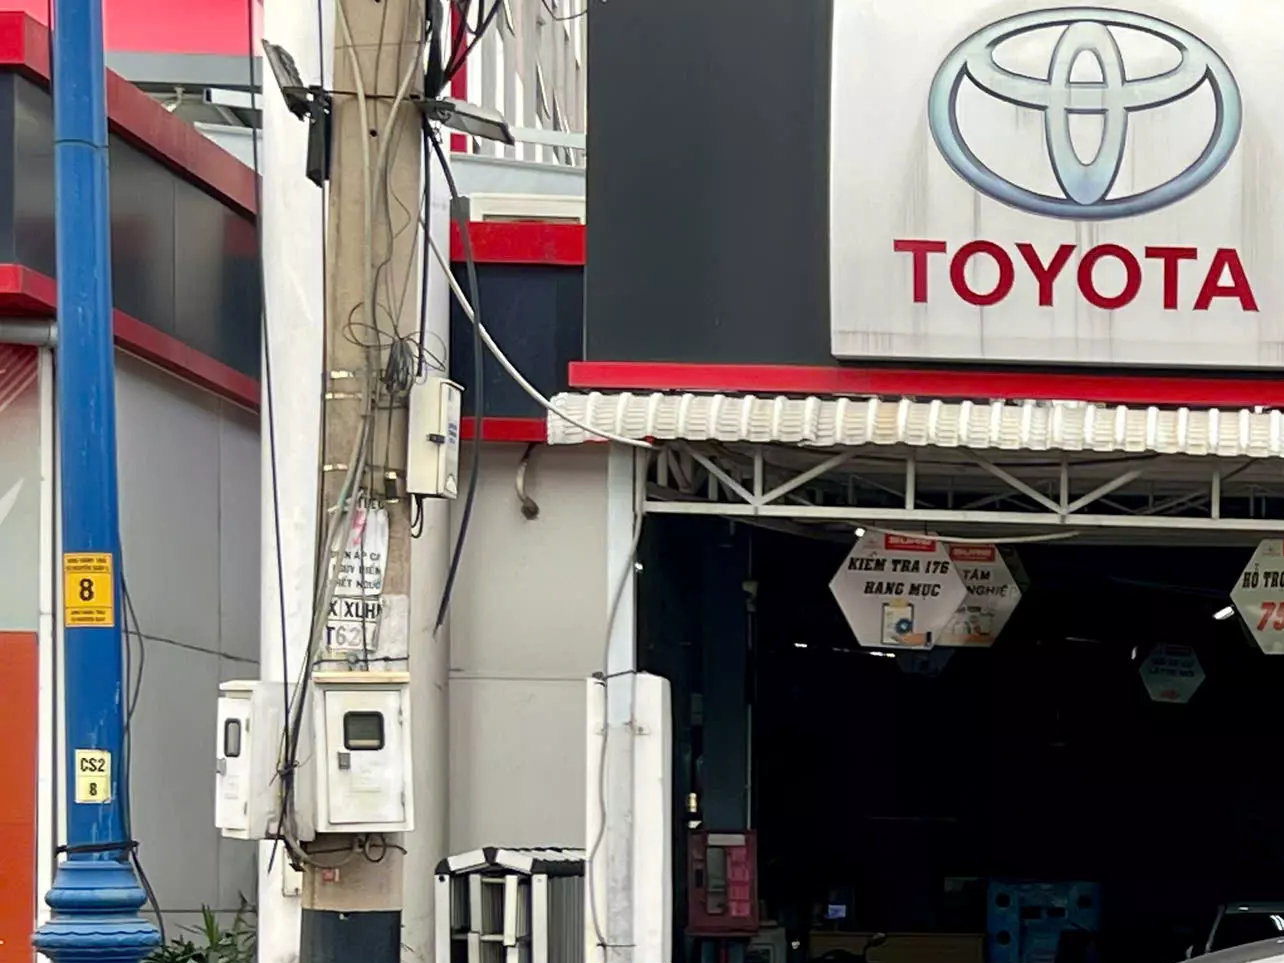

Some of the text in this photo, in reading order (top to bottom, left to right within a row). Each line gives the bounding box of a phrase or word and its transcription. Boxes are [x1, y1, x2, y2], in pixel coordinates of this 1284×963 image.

[893, 239, 1259, 312] TOYOTA
[892, 559, 920, 573] TRA
[79, 578, 95, 601] 8
[80, 757, 106, 772] CS2
[89, 782, 98, 796] 8
